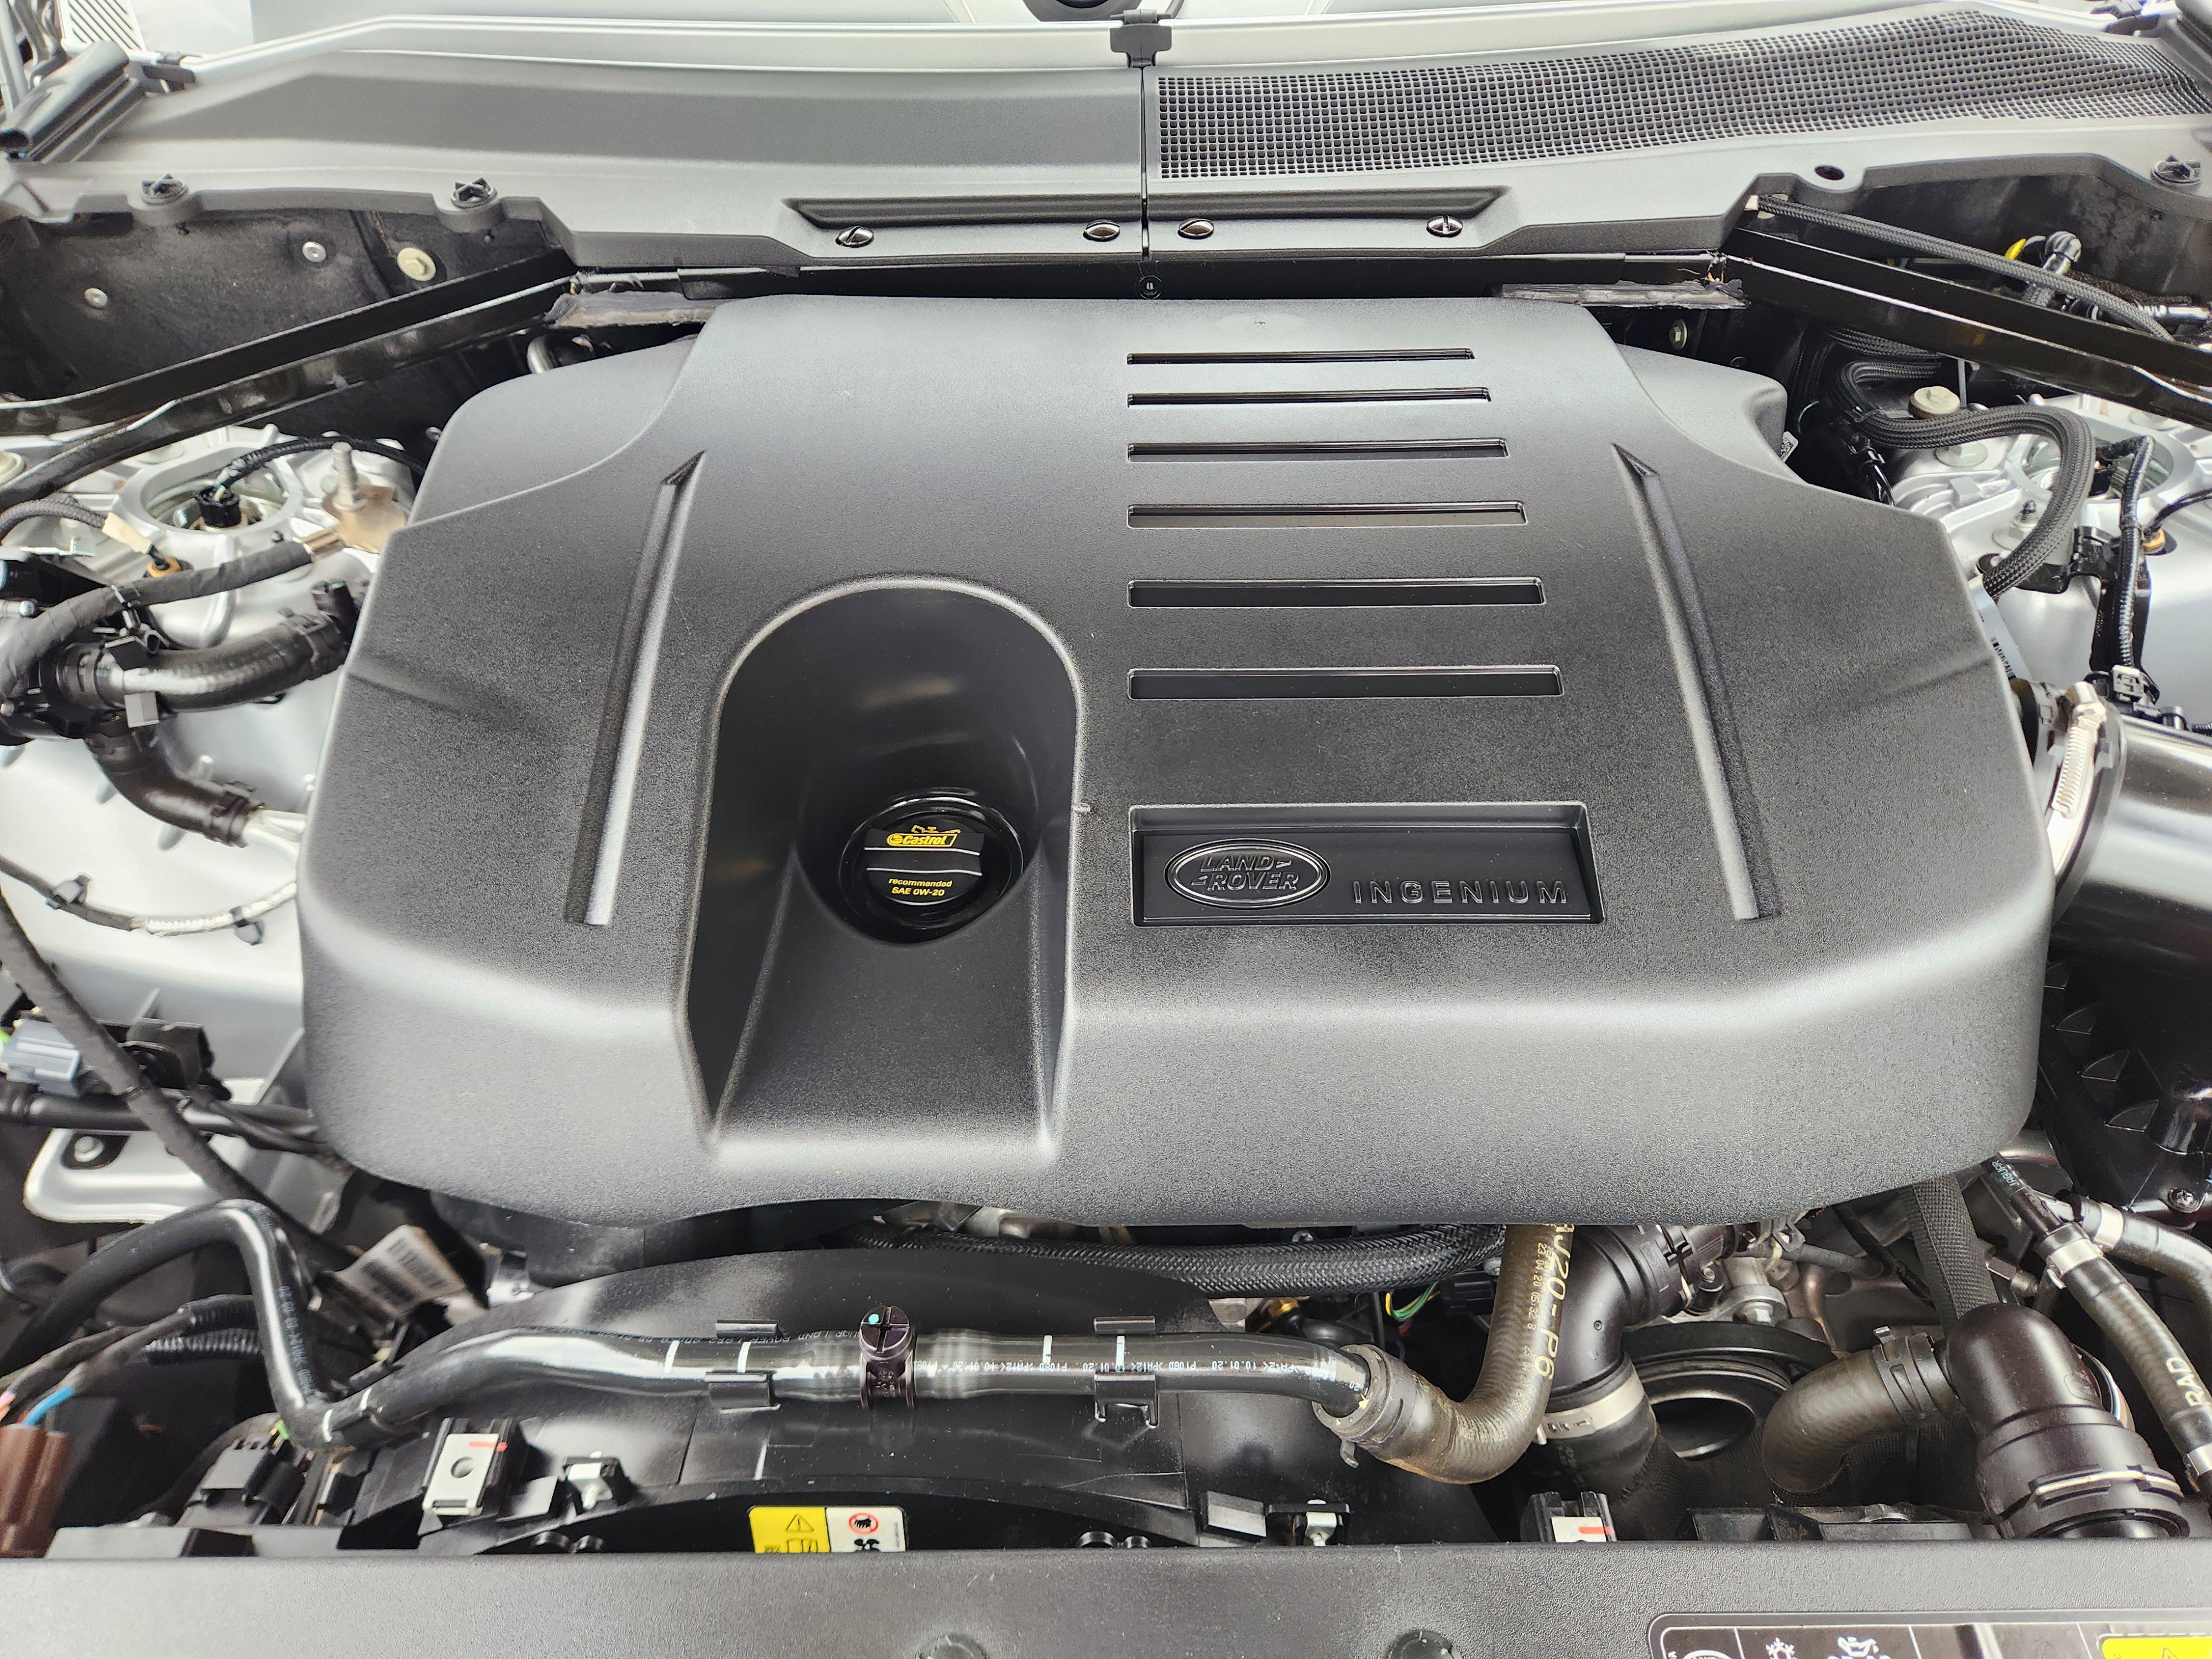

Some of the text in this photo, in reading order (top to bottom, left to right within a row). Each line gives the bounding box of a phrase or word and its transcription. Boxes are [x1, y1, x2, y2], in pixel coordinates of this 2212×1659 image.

[901, 834, 946, 845] Castrol
[1200, 855, 1274, 872] LAND
[889, 877, 952, 888] recommended
[1207, 872, 1299, 891] ROVER
[891, 886, 945, 896] SAE 0W-20
[1353, 880, 1567, 904] INGENIUM
[1991, 1159, 2021, 1187] JAGUAR
[1533, 1242, 1547, 1287] 23.04.20
[1211, 1360, 1257, 1370] 10.01.20
[2166, 1357, 2212, 1407] RAD
